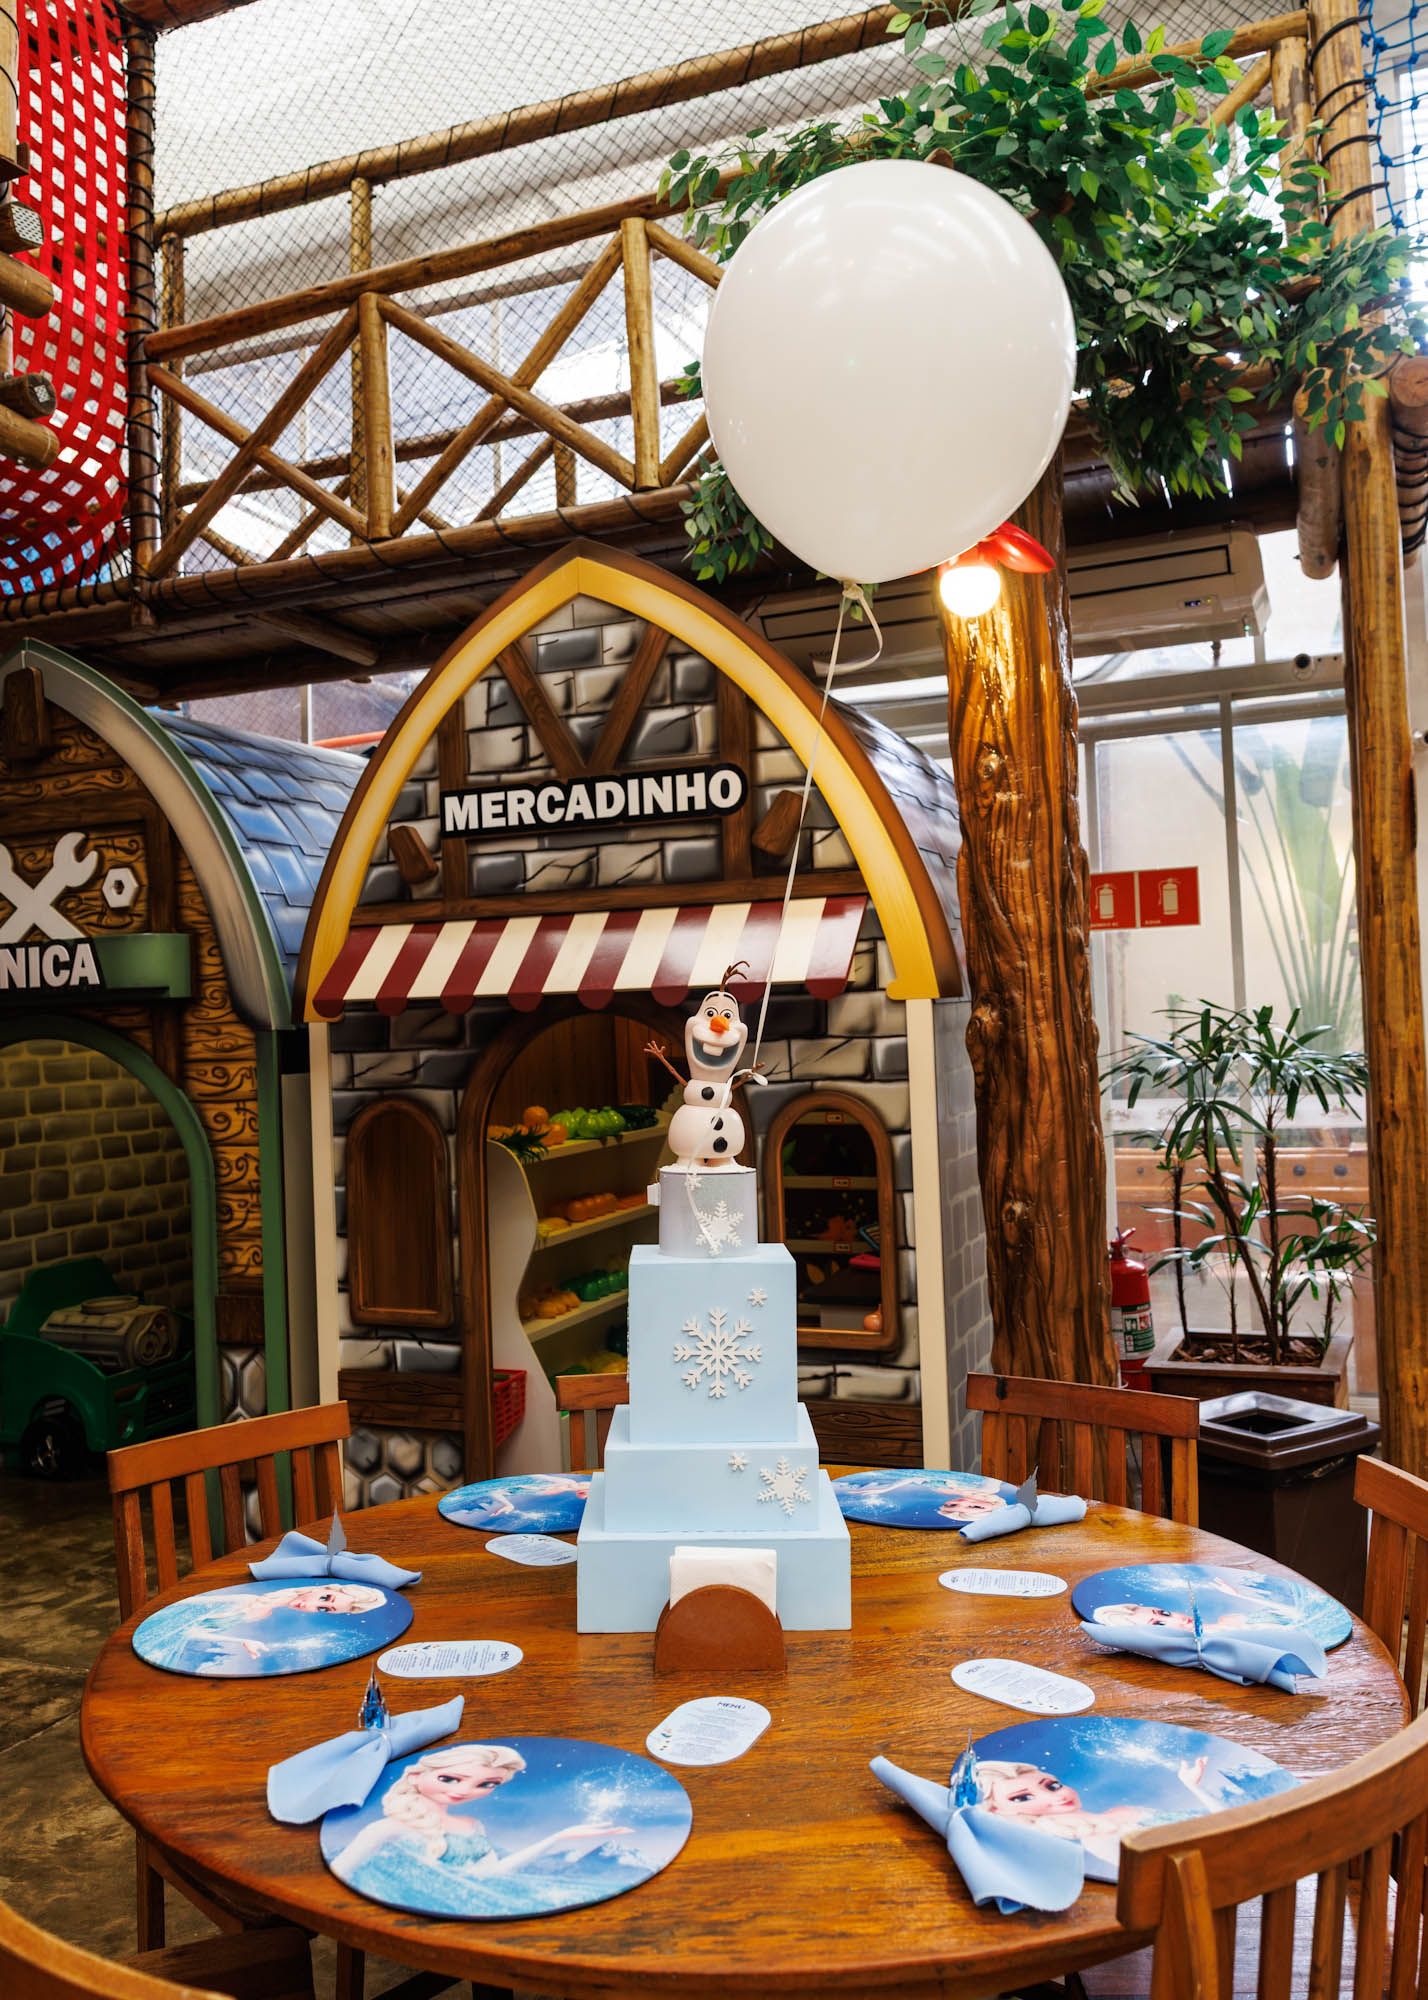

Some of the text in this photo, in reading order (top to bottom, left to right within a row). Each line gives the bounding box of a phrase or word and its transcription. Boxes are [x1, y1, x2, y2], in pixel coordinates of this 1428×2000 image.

[444, 768, 744, 832] MERCADINHO
[0, 943, 101, 990] NICA
[717, 1701, 746, 1710] MENU
